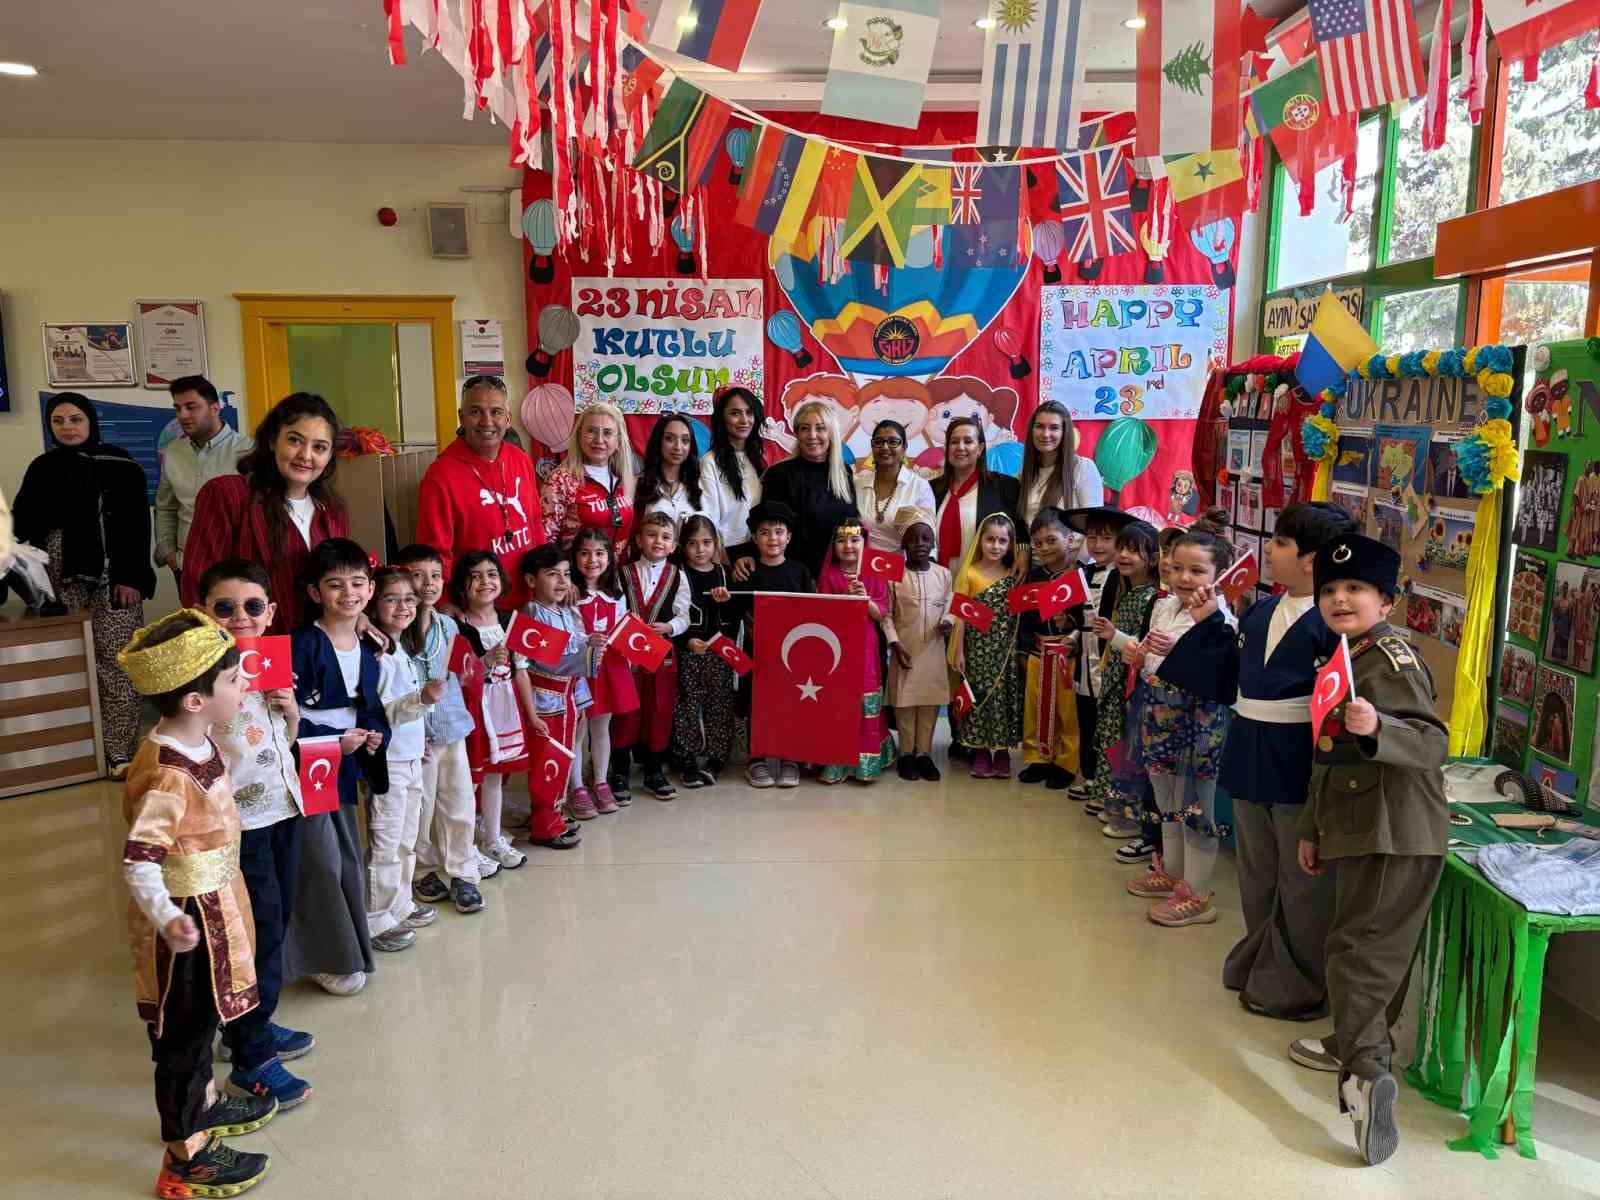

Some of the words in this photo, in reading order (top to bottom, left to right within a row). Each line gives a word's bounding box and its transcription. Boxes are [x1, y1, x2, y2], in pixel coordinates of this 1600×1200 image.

[577, 287, 631, 319] 23
[1061, 298, 1204, 330] HAPPY
[592, 327, 737, 358] KUTLU
[1061, 344, 1192, 379] APRIL
[596, 363, 730, 396] OLSUN
[1345, 376, 1477, 422] UKRAINE
